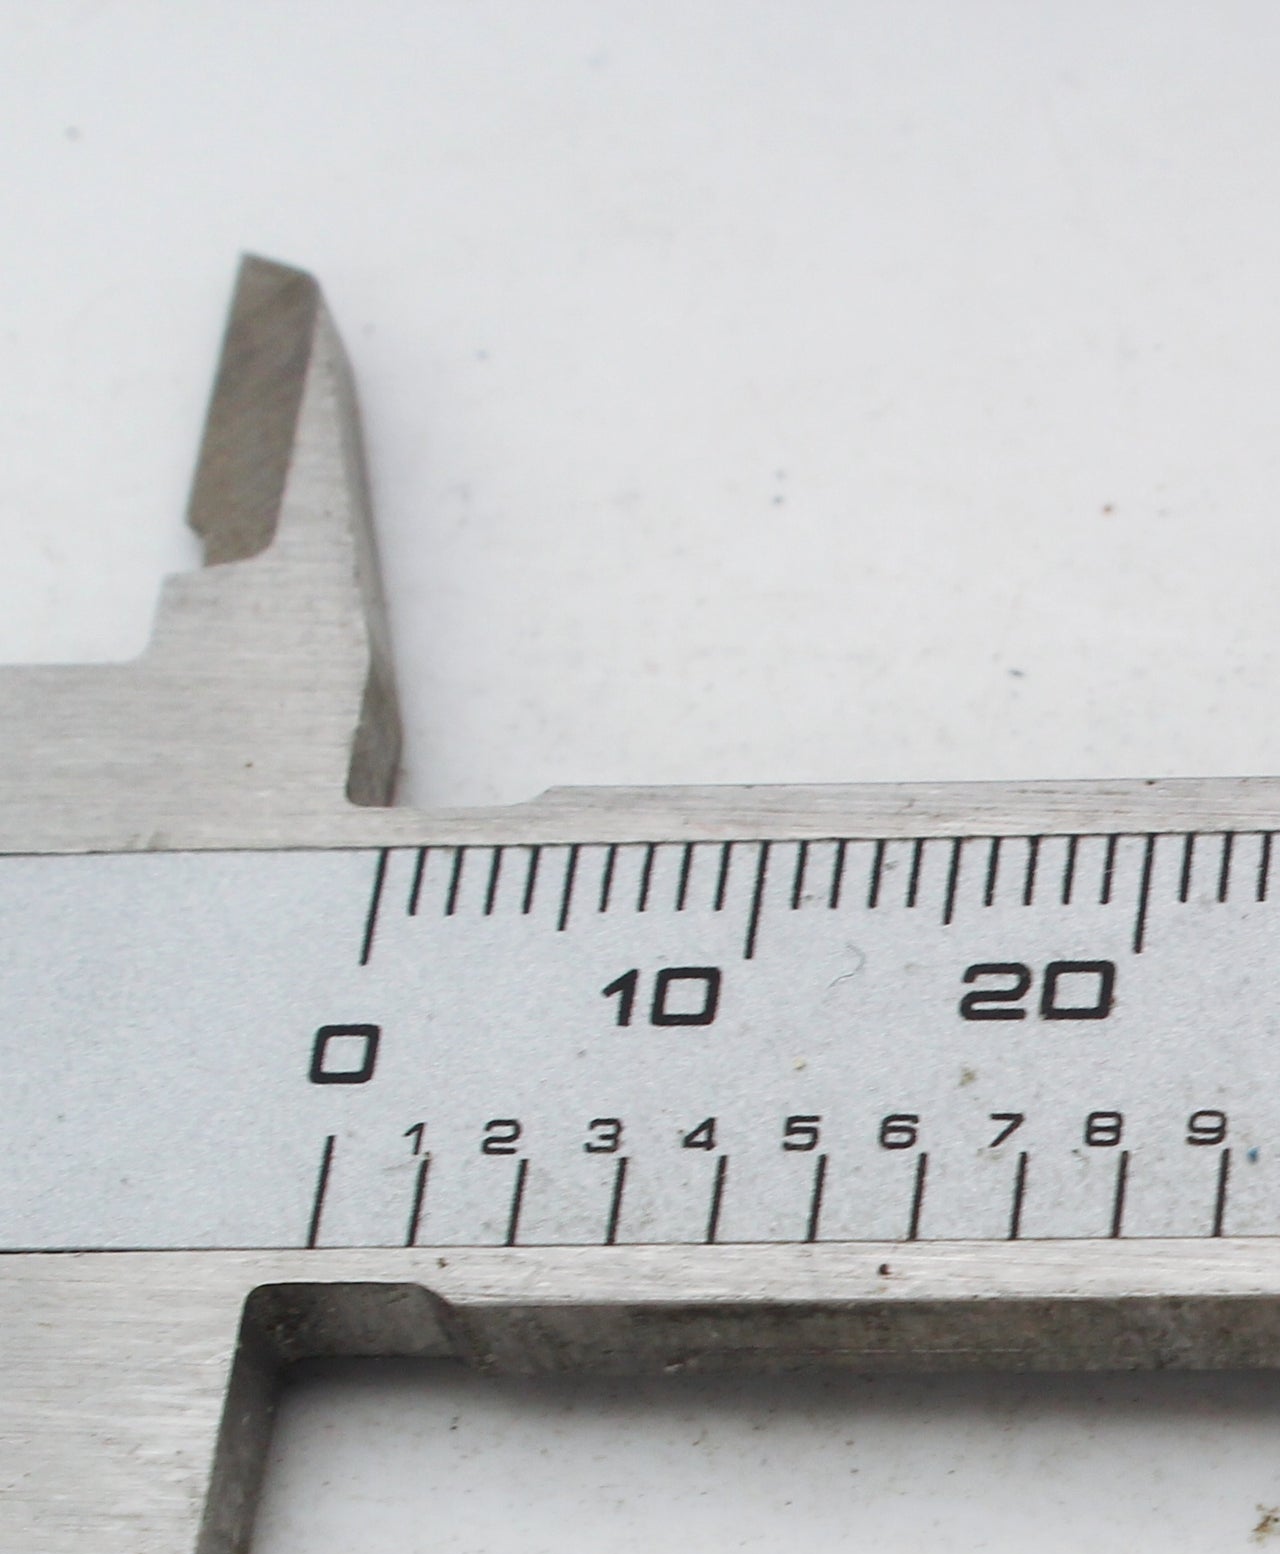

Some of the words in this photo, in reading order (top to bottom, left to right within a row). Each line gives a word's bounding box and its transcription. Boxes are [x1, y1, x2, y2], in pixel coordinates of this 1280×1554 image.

[309, 1023, 380, 1085] 0
[602, 967, 722, 1026] 10
[959, 960, 1117, 1021] 20
[403, 1122, 426, 1155] 1
[482, 1119, 522, 1155] 2
[584, 1117, 622, 1153] 3
[683, 1117, 718, 1151] 4
[782, 1115, 822, 1152] 5
[879, 1114, 919, 1150] 6
[988, 1113, 1024, 1148] 7
[1085, 1111, 1123, 1148] 8
[1187, 1109, 1228, 1146] 9
